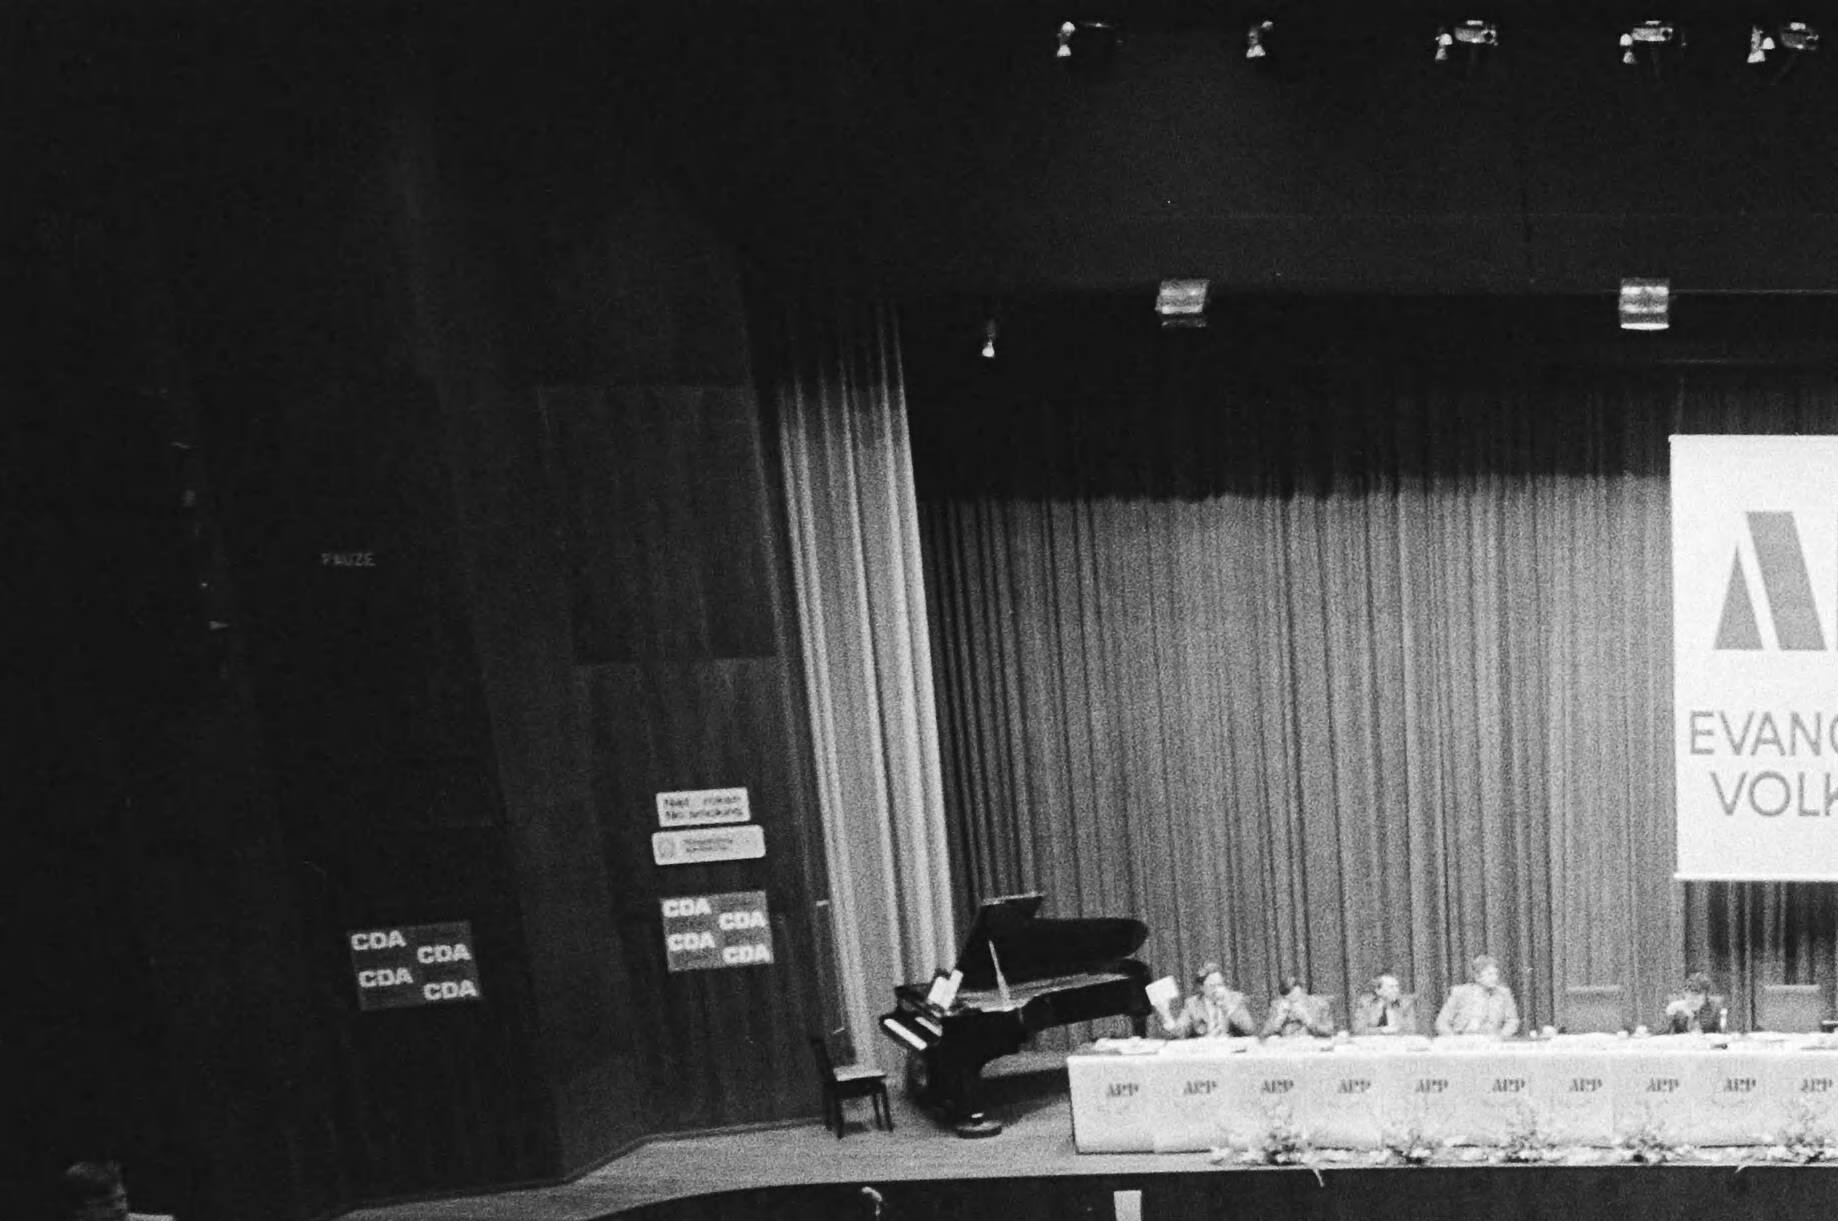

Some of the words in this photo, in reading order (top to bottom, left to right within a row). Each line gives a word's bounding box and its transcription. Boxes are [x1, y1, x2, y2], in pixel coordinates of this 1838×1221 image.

[663, 898, 711, 917] CDA
[719, 911, 766, 930] CDA
[351, 930, 407, 951] CDA
[668, 932, 715, 951] CDA
[417, 943, 471, 964] CDA
[723, 944, 770, 963] CDA
[358, 967, 414, 988] CDA
[423, 979, 478, 1001] CDA
